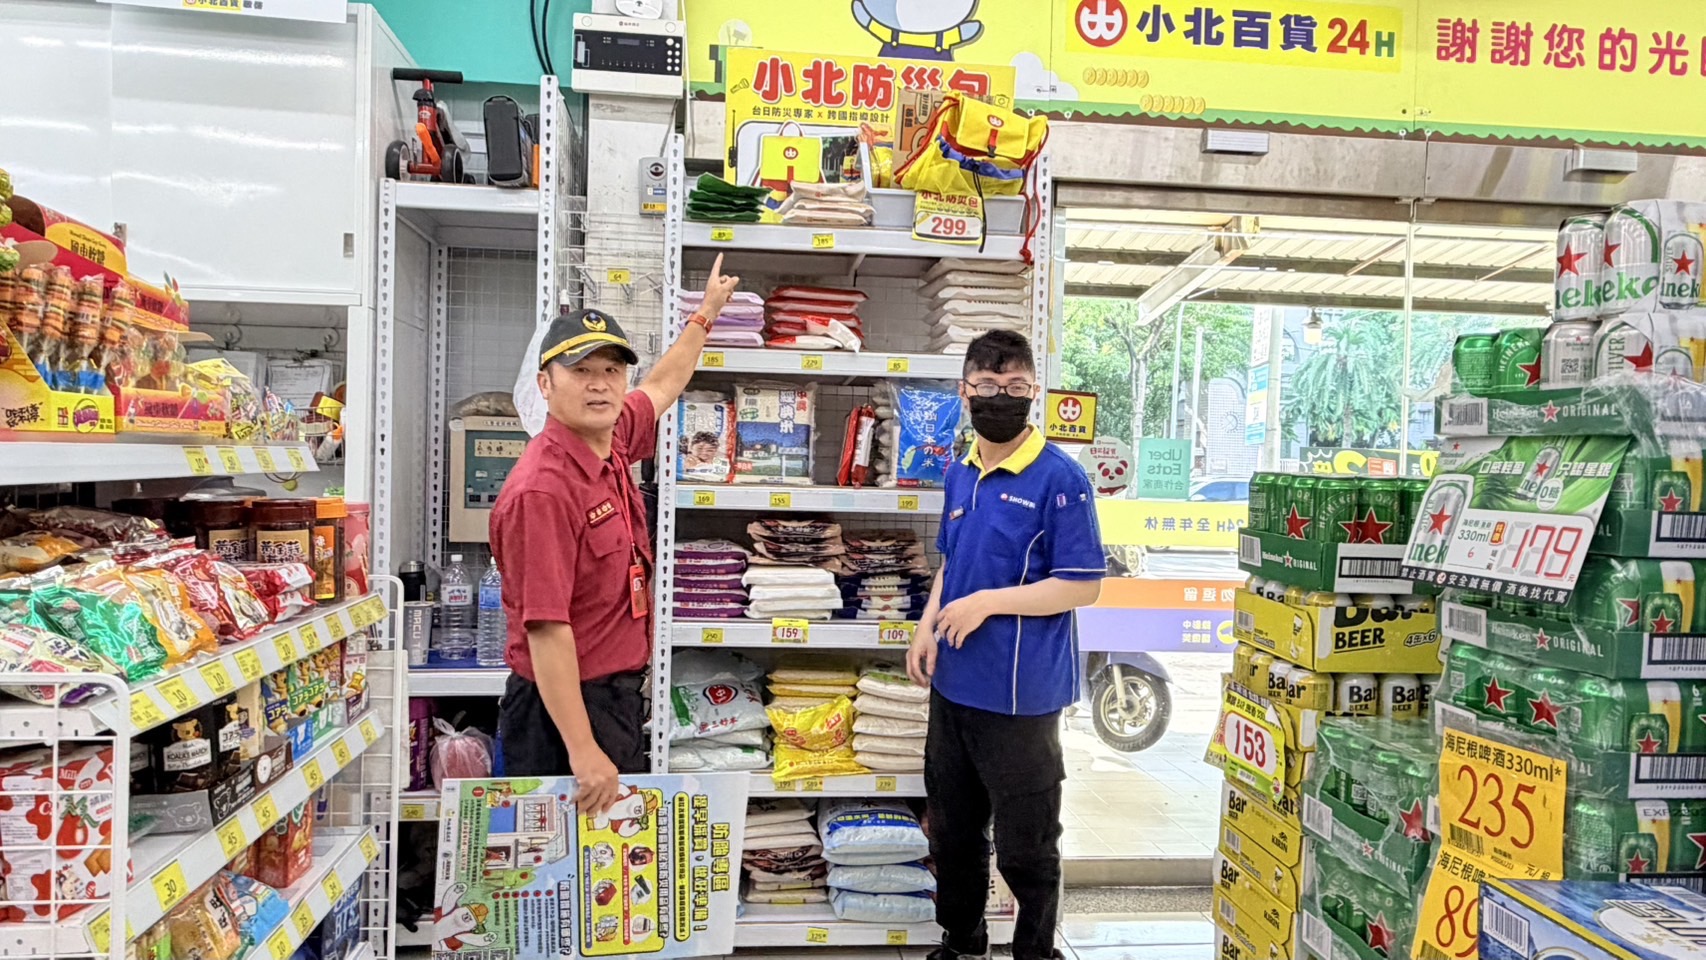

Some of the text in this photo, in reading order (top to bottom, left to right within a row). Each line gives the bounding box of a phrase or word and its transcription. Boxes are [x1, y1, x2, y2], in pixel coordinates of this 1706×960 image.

[1436, 18, 1706, 78] 謝謝您的光
[931, 216, 966, 236] 299
[1562, 403, 1618, 417] ORIGINAL
[1049, 423, 1087, 434] 小北百貨
[1457, 529, 1490, 542] 330ml
[1511, 524, 1583, 578] 179
[1505, 583, 1568, 603] 酒後找代駕
[781, 627, 799, 638] 159
[886, 629, 904, 640] 109
[1334, 628, 1385, 650] BEER
[1553, 636, 1604, 658] ORIGINAL
[212, 673, 224, 686] 10
[171, 689, 187, 703] 10
[1234, 719, 1266, 768] 153
[1229, 790, 1247, 814] Bar
[1457, 764, 1536, 850] 235
[261, 807, 271, 819] 45
[227, 832, 237, 845] 45
[1221, 859, 1239, 884] Bar
[163, 881, 177, 894] 30
